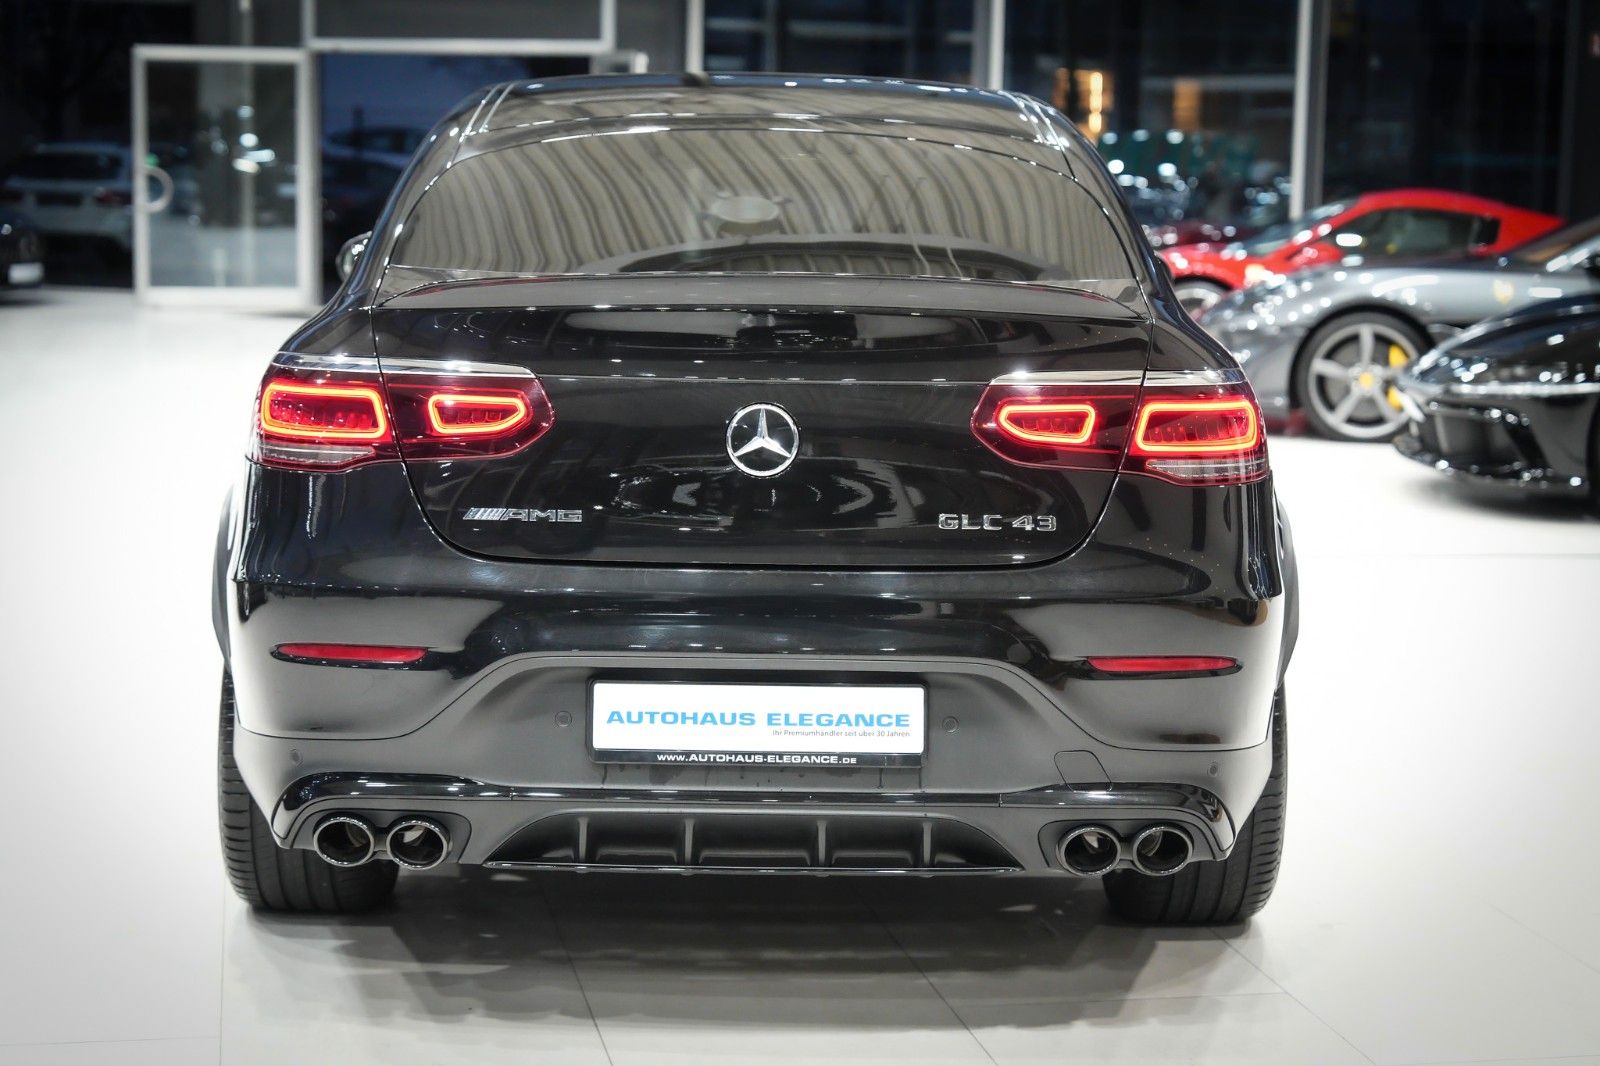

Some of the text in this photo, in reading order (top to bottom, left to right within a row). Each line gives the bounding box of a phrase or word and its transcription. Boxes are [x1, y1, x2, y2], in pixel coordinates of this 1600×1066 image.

[500, 508, 582, 522] AMG
[938, 513, 1057, 531] GLC 43
[606, 711, 910, 727] AUTOHAUS ELEGANCE
[656, 753, 857, 764] www.AUTOHAUS-ELEGANCE.DE
